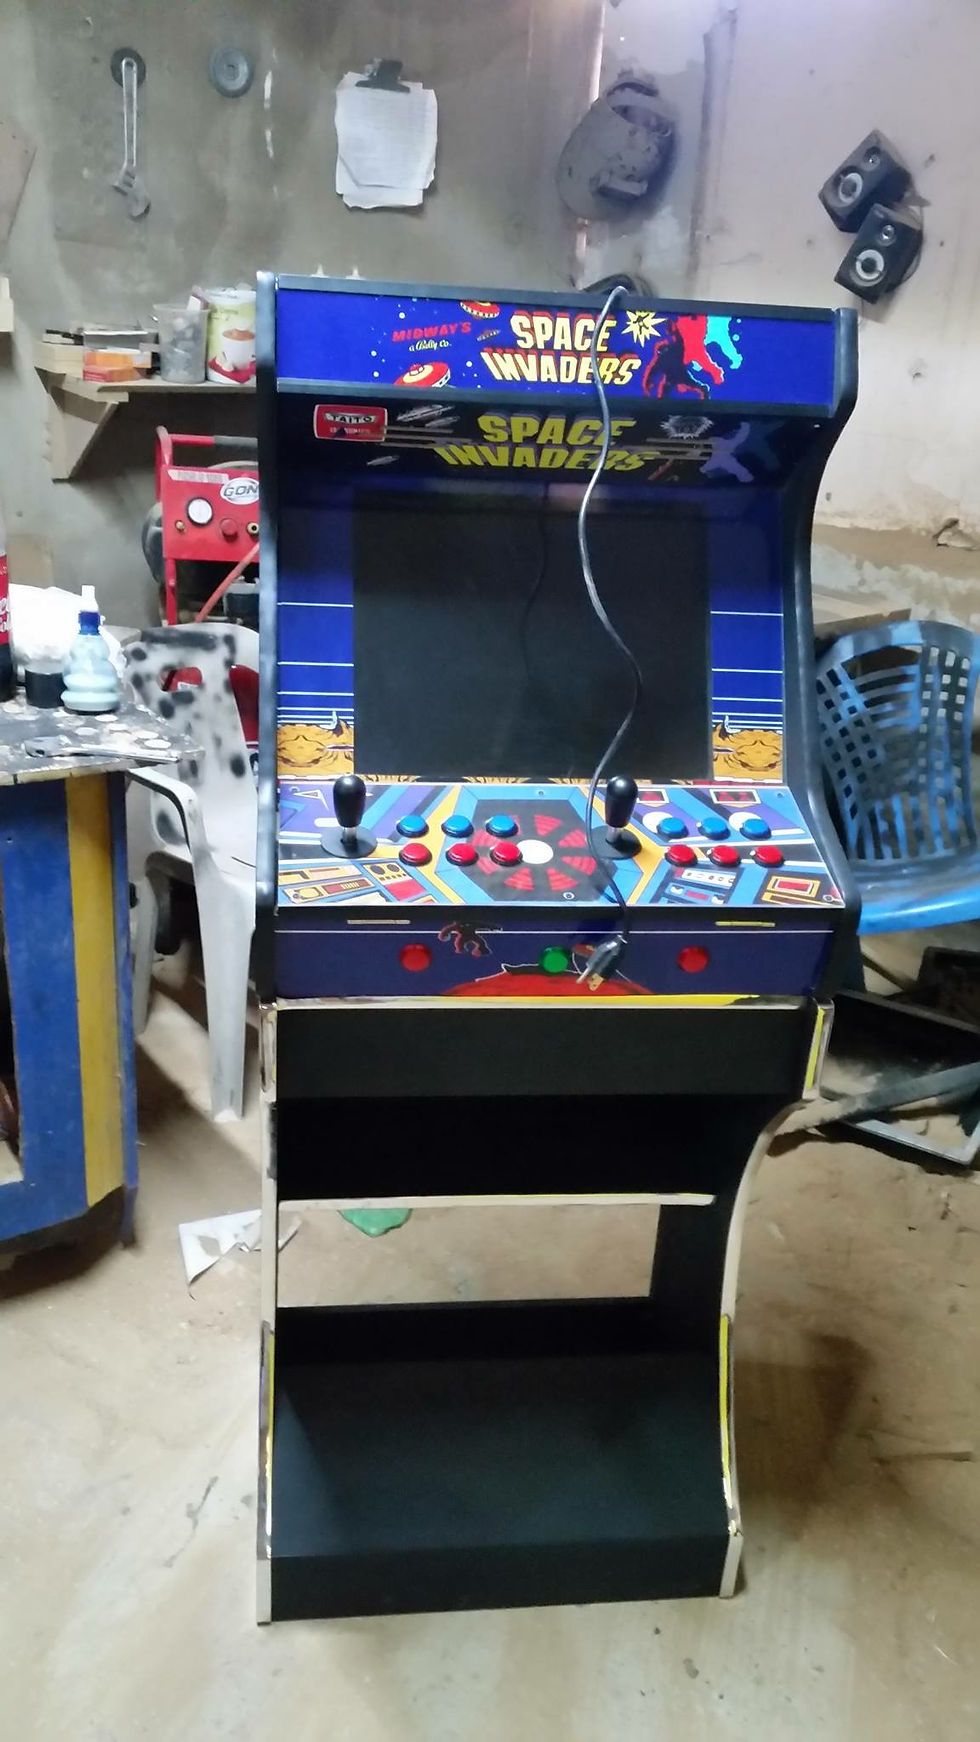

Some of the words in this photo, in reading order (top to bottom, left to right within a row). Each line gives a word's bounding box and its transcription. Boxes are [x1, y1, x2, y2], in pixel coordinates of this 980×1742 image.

[391, 321, 472, 342] MIDWAY'S
[509, 311, 618, 352] SPACE
[480, 349, 643, 386] INVADERS
[329, 413, 374, 424] TAITO
[476, 413, 637, 446] SPACE
[432, 444, 661, 471] INVADERS
